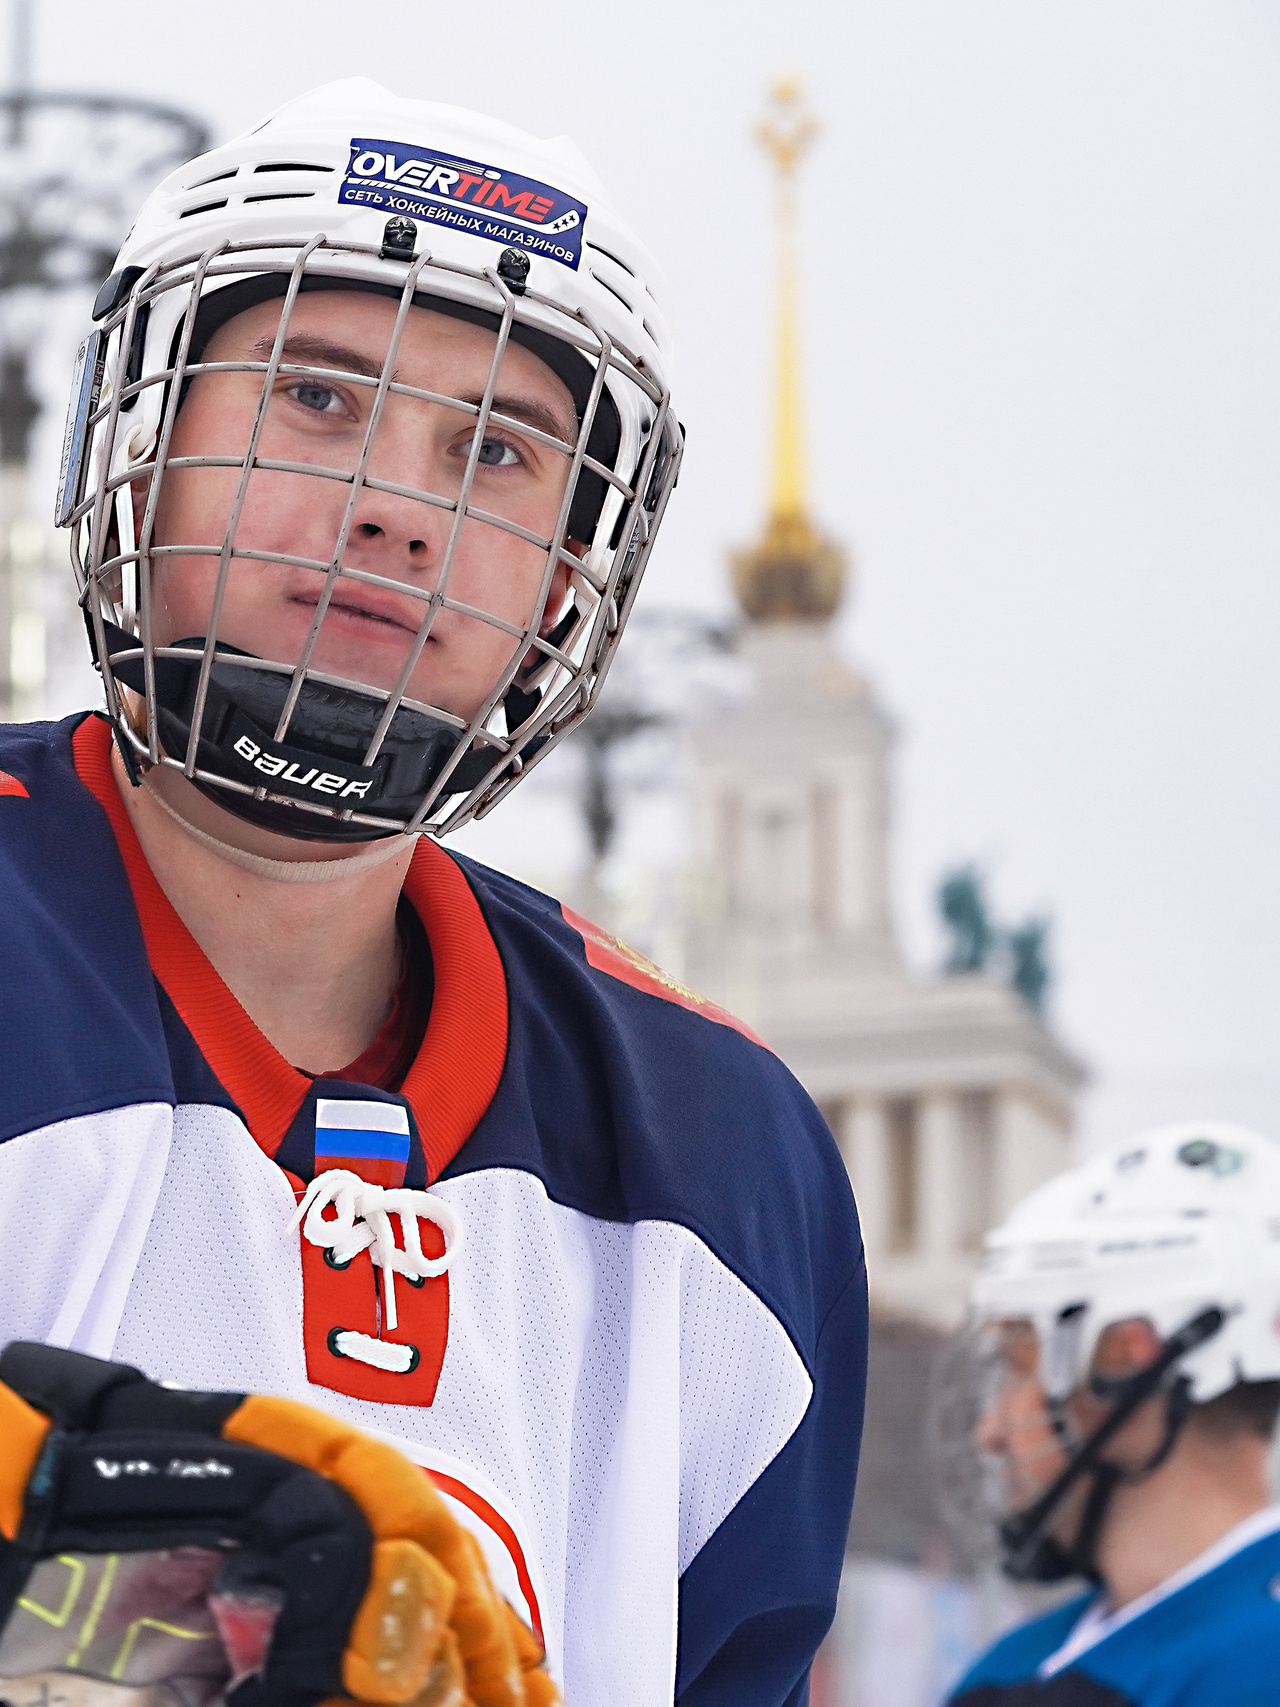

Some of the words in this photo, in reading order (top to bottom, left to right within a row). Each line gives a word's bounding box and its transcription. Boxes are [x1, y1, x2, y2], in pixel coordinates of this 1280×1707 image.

[352, 150, 554, 222] OVERTIME
[344, 189, 384, 204] СЕТЬ
[385, 195, 483, 231] ХОККЕЙНЫХ
[484, 224, 575, 262] МАГАЗИНОВ
[233, 735, 373, 799] BAUER
